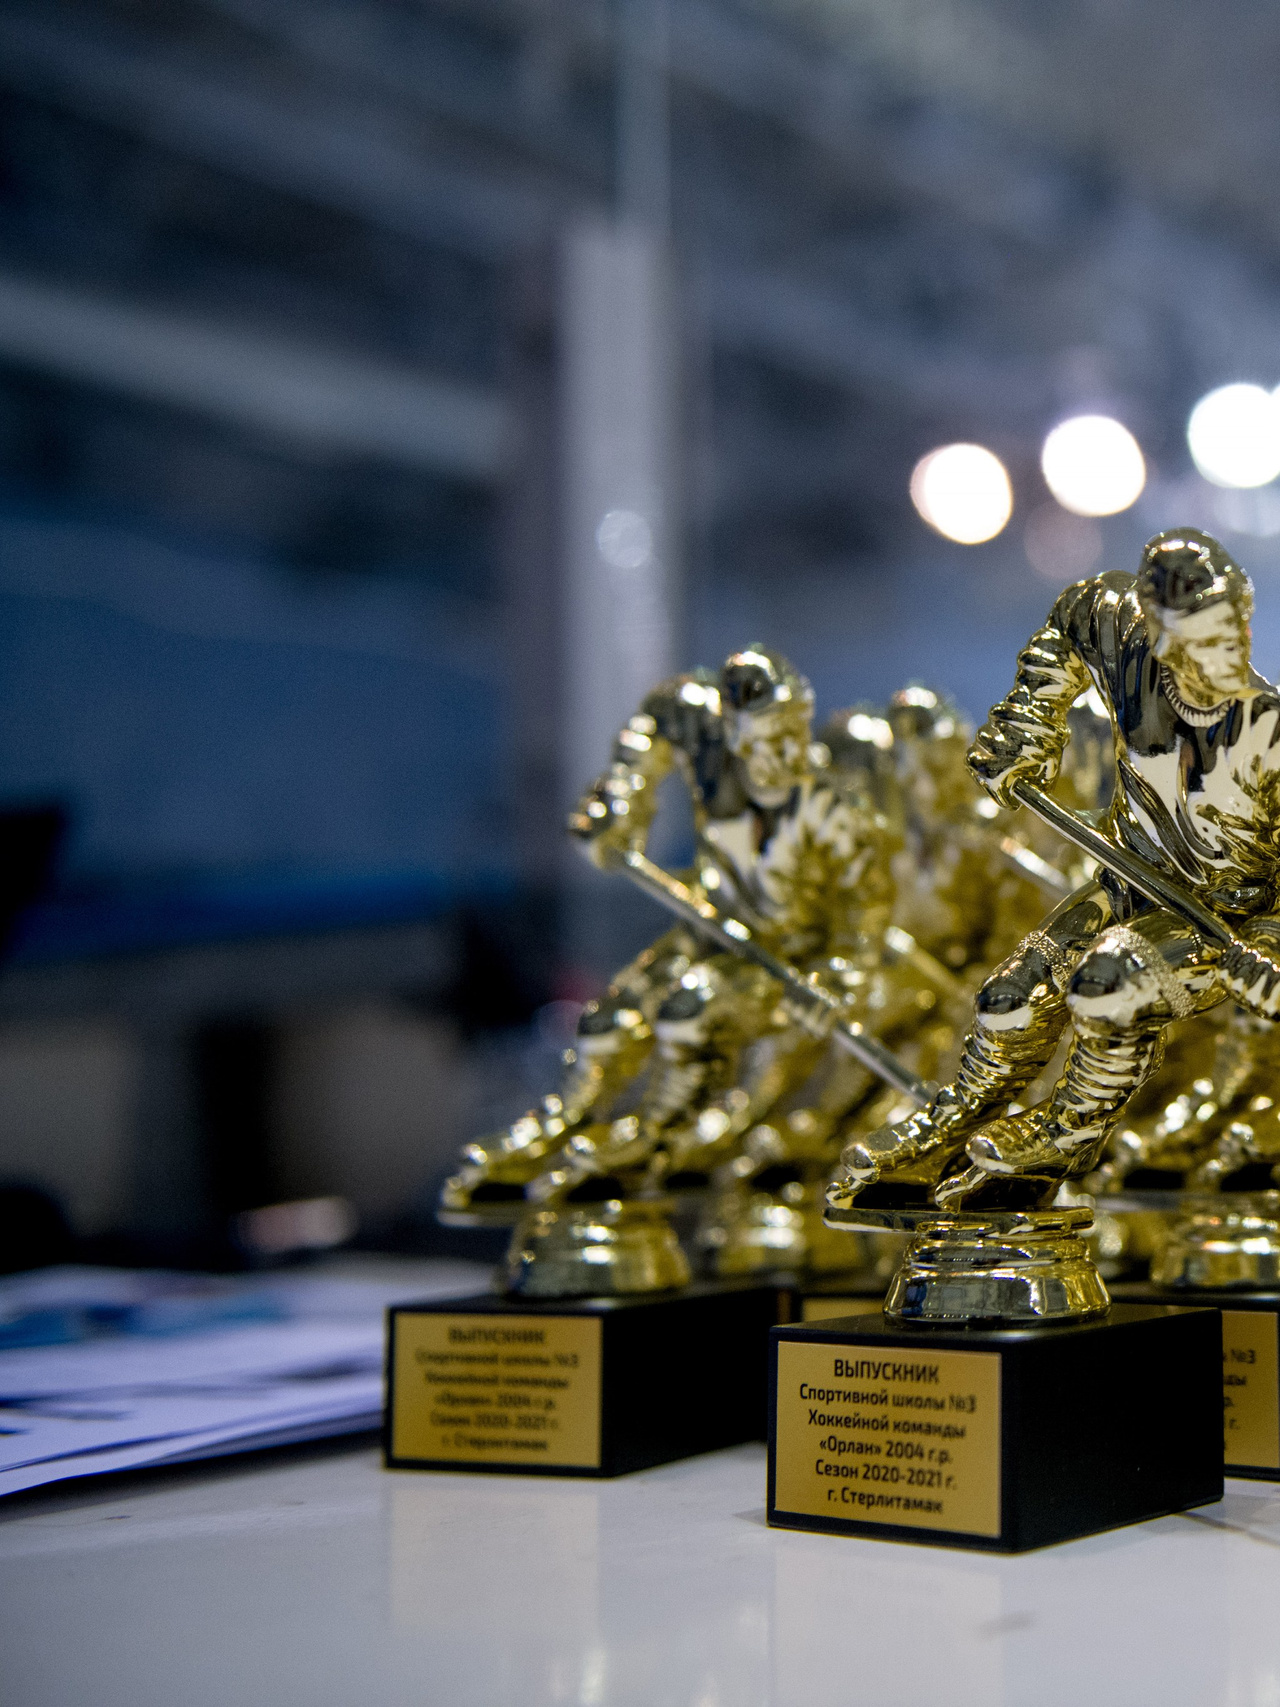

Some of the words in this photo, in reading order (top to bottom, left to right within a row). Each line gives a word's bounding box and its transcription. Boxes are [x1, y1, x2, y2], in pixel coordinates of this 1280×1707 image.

[834, 1359, 940, 1384] ВЫПУСКНИК
[800, 1383, 888, 1405] Спортивной
[892, 1394, 945, 1410] школы
[949, 1394, 977, 1413] №3
[808, 1409, 889, 1432] Хоккейной
[893, 1422, 967, 1441] команды
[819, 1435, 882, 1456] «Орлан»
[886, 1441, 924, 1461] 2004
[928, 1449, 953, 1466] г.р.
[815, 1459, 858, 1479] Сезон
[862, 1463, 942, 1488] 2020-2021
[946, 1477, 958, 1491] г.
[827, 1488, 837, 1502] г.
[841, 1487, 944, 1514] Стерлитамак
